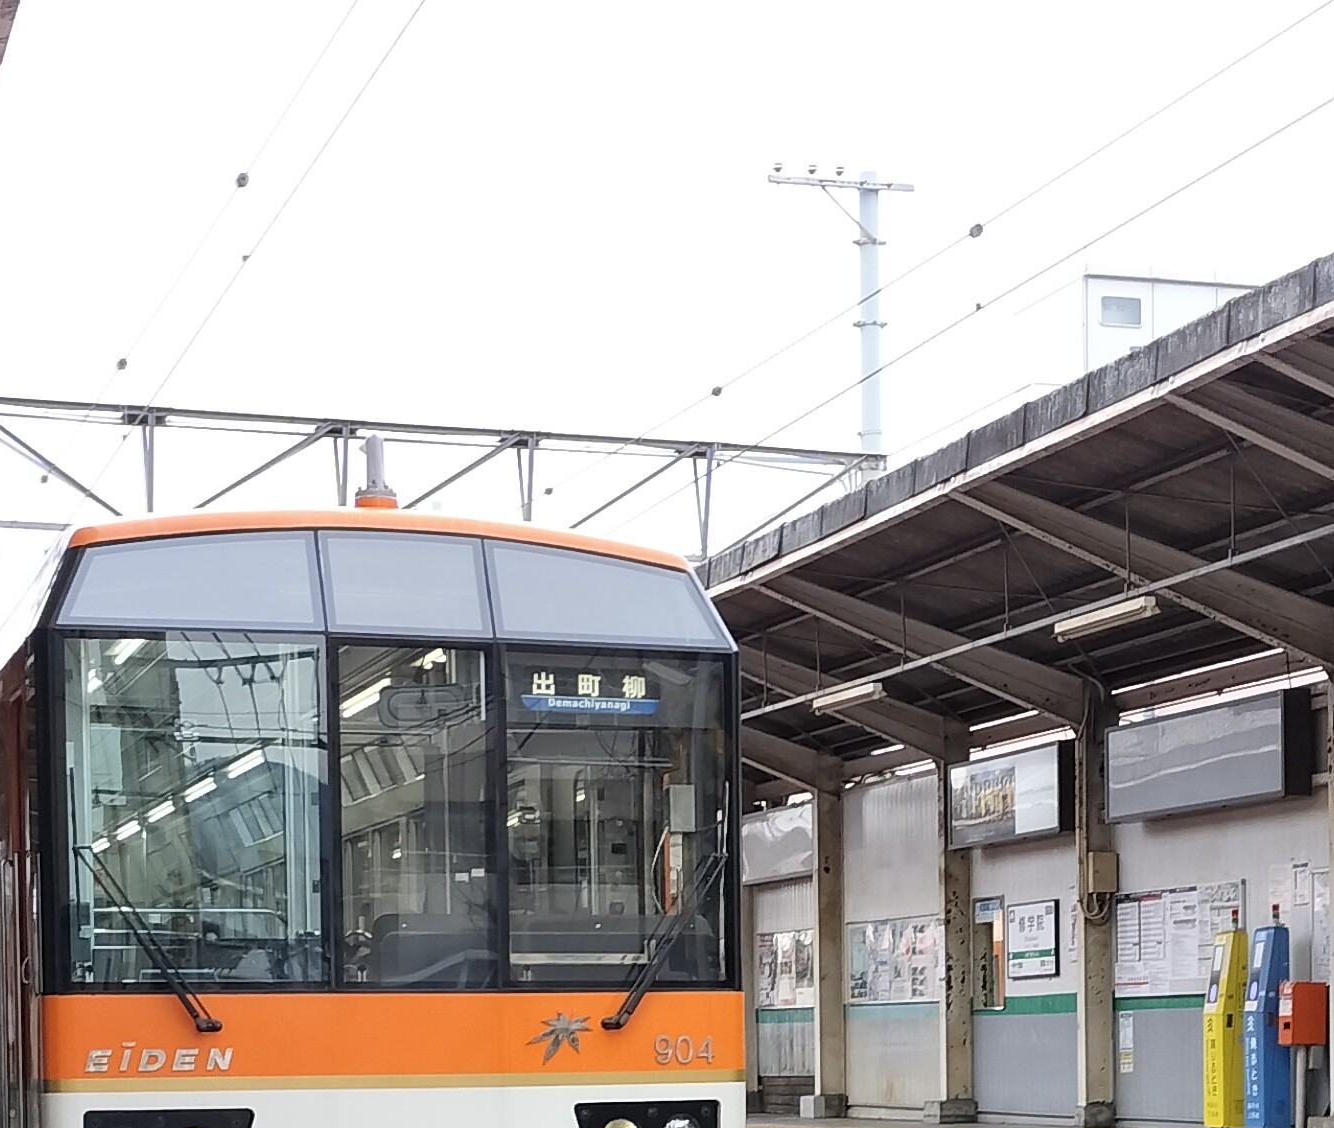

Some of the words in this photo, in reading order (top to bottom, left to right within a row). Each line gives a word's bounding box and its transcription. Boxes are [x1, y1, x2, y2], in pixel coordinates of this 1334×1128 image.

[532, 671, 646, 699] 出町柳
[548, 698, 631, 712] Demachiyanagi
[654, 1034, 716, 1065] 904
